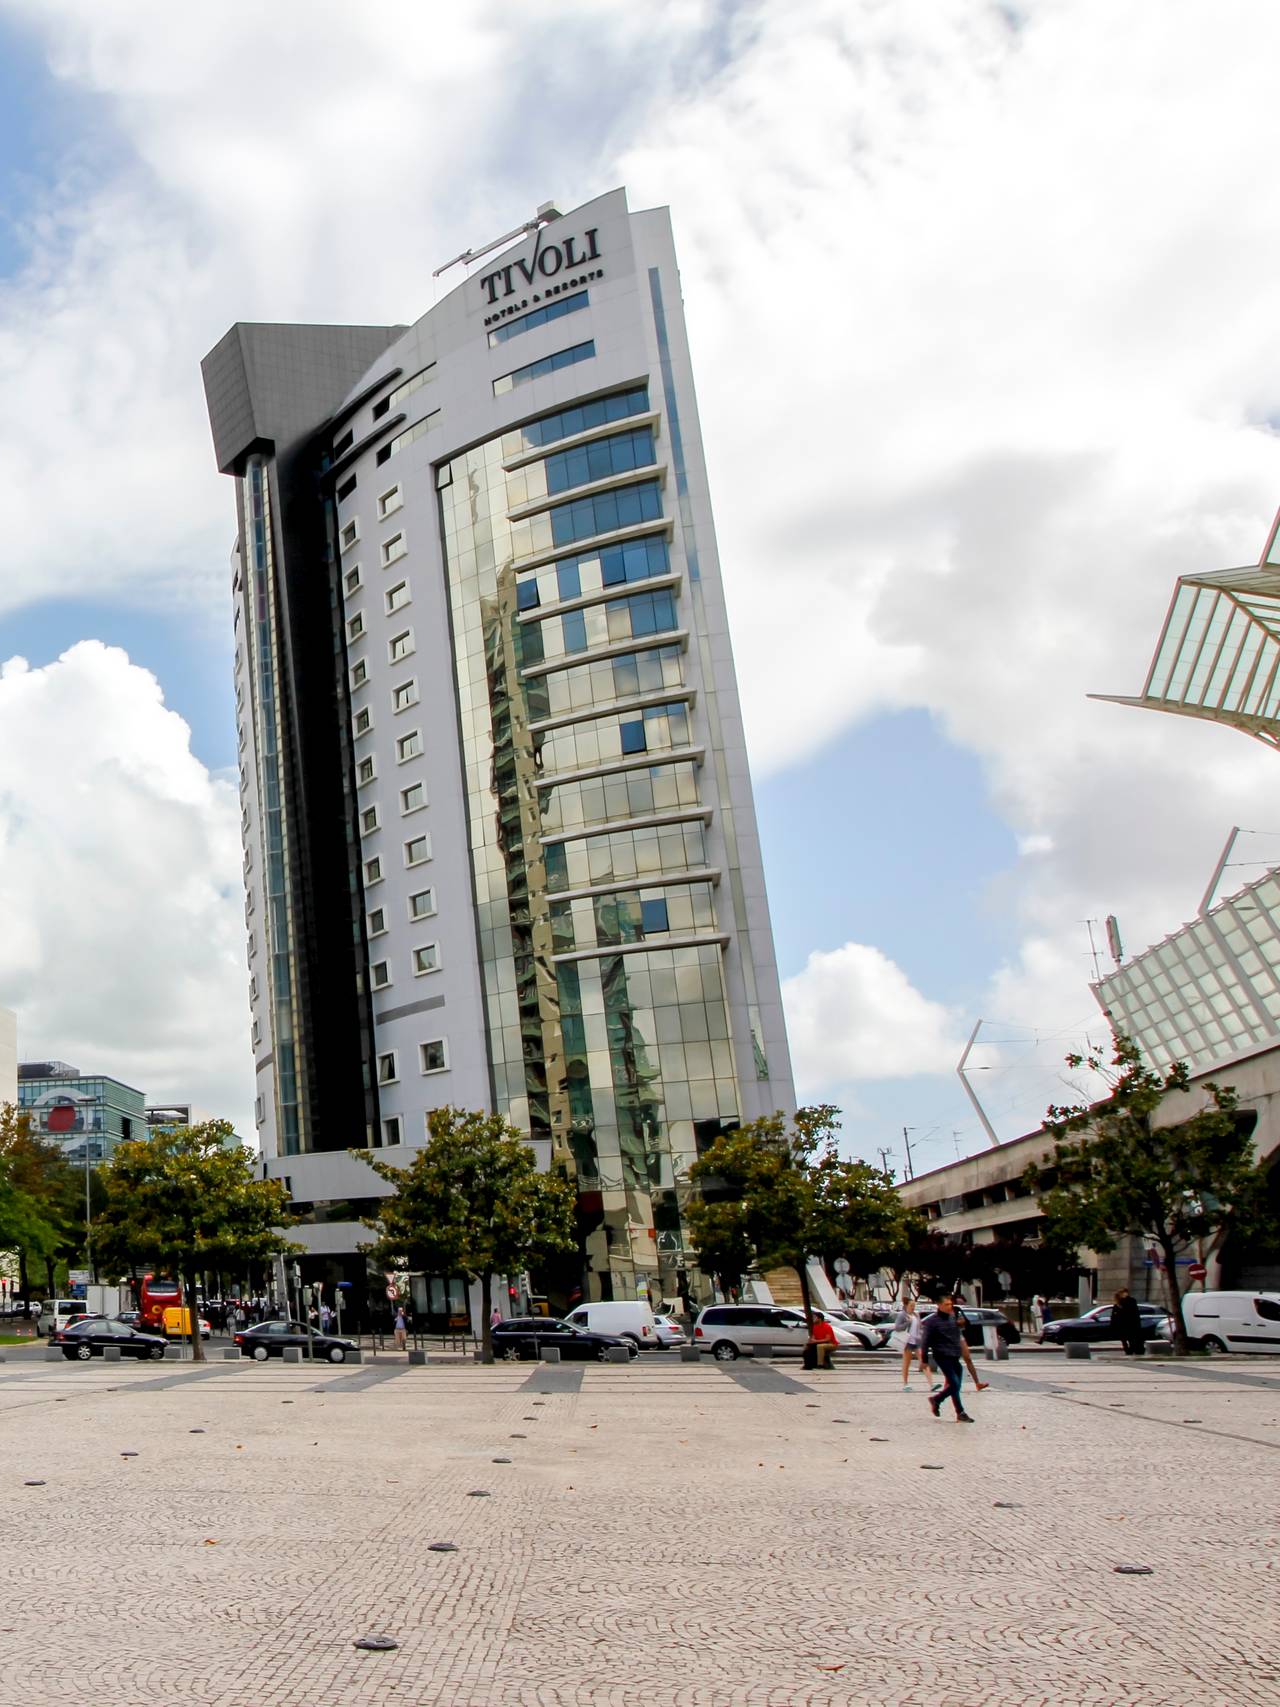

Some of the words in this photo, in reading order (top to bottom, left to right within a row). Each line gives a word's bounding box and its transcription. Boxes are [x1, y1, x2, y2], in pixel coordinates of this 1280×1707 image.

[480, 228, 601, 305] TIVOLI
[484, 299, 528, 326] HOTELS
[533, 294, 541, 303] &
[545, 269, 604, 298] RESORTS
